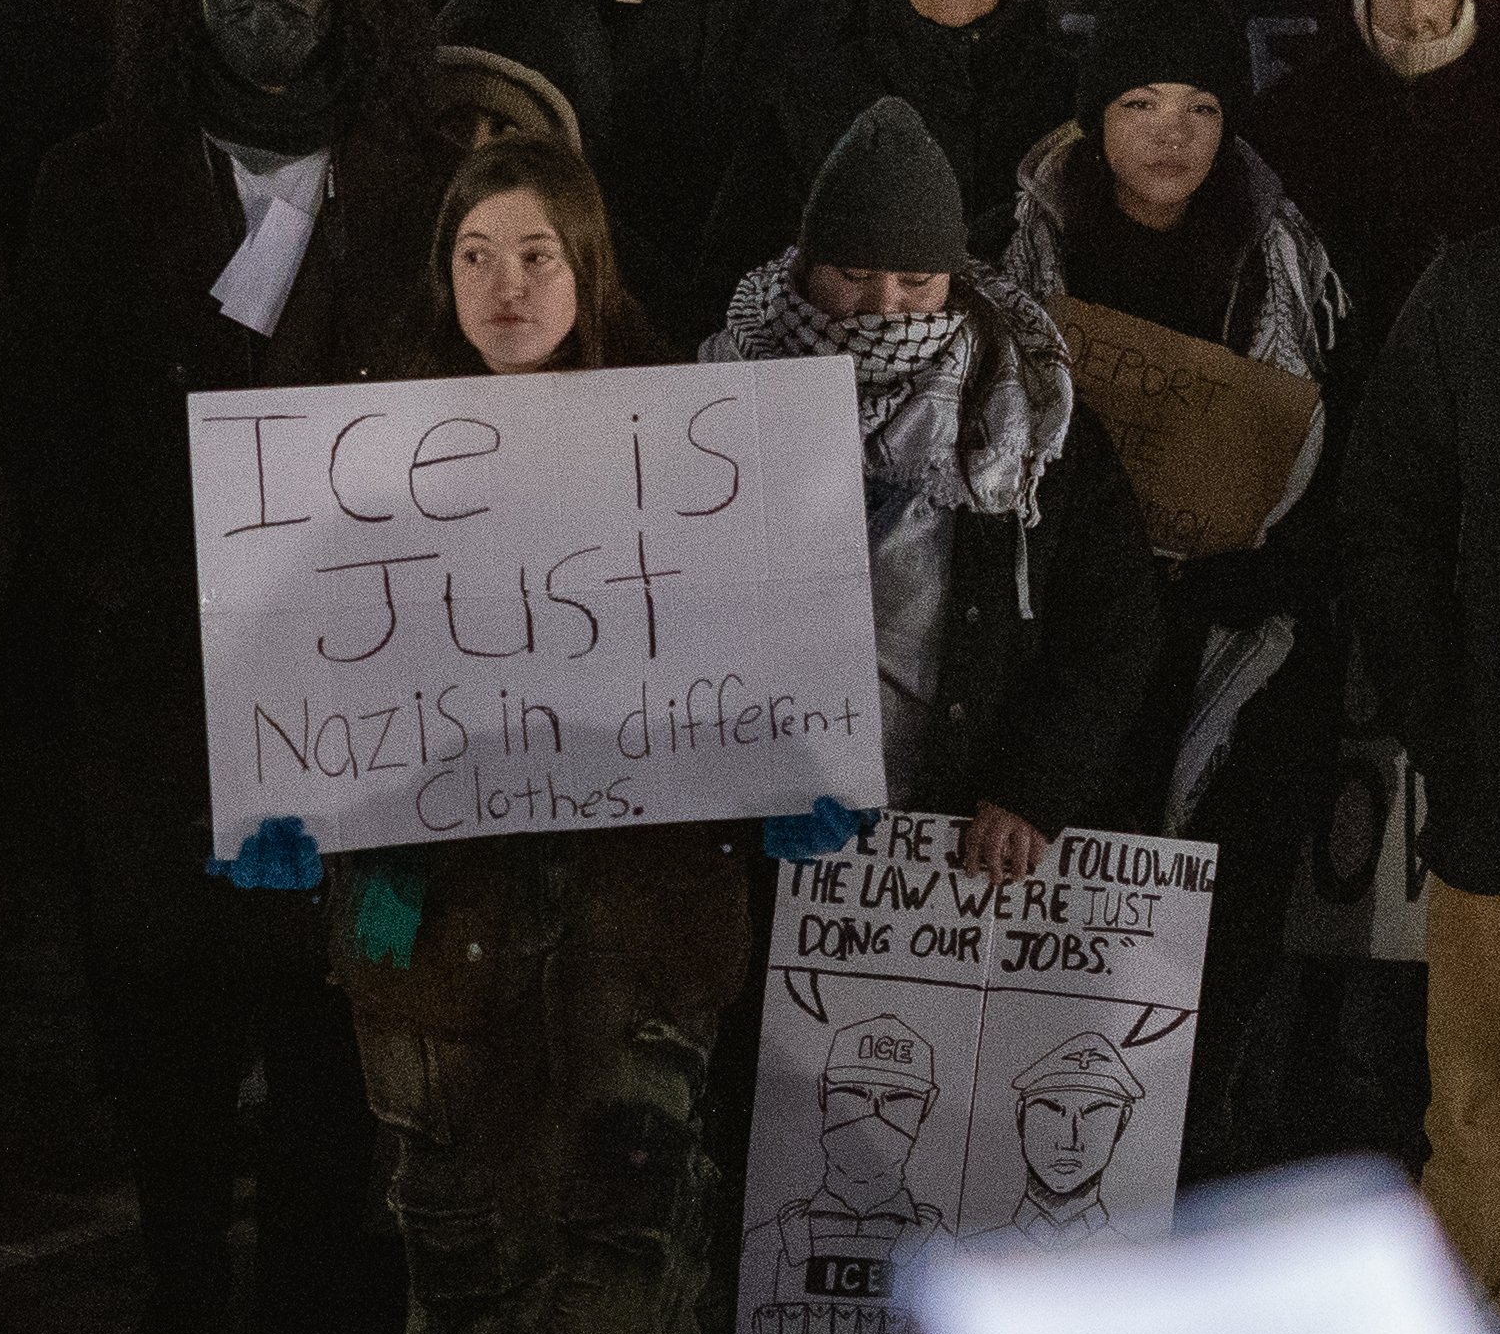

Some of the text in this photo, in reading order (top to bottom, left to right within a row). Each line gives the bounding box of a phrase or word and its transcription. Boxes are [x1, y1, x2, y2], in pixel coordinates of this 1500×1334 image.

[253, 672, 862, 785] Nazis in different
[1058, 835, 1215, 894] FOLLOWING
[790, 857, 848, 905] THE
[1082, 884, 1162, 930] JUST
[798, 913, 894, 962] DOING
[909, 922, 981, 964] OUR
[857, 1034, 915, 1065] ICE
[824, 1261, 881, 1293] ICE
